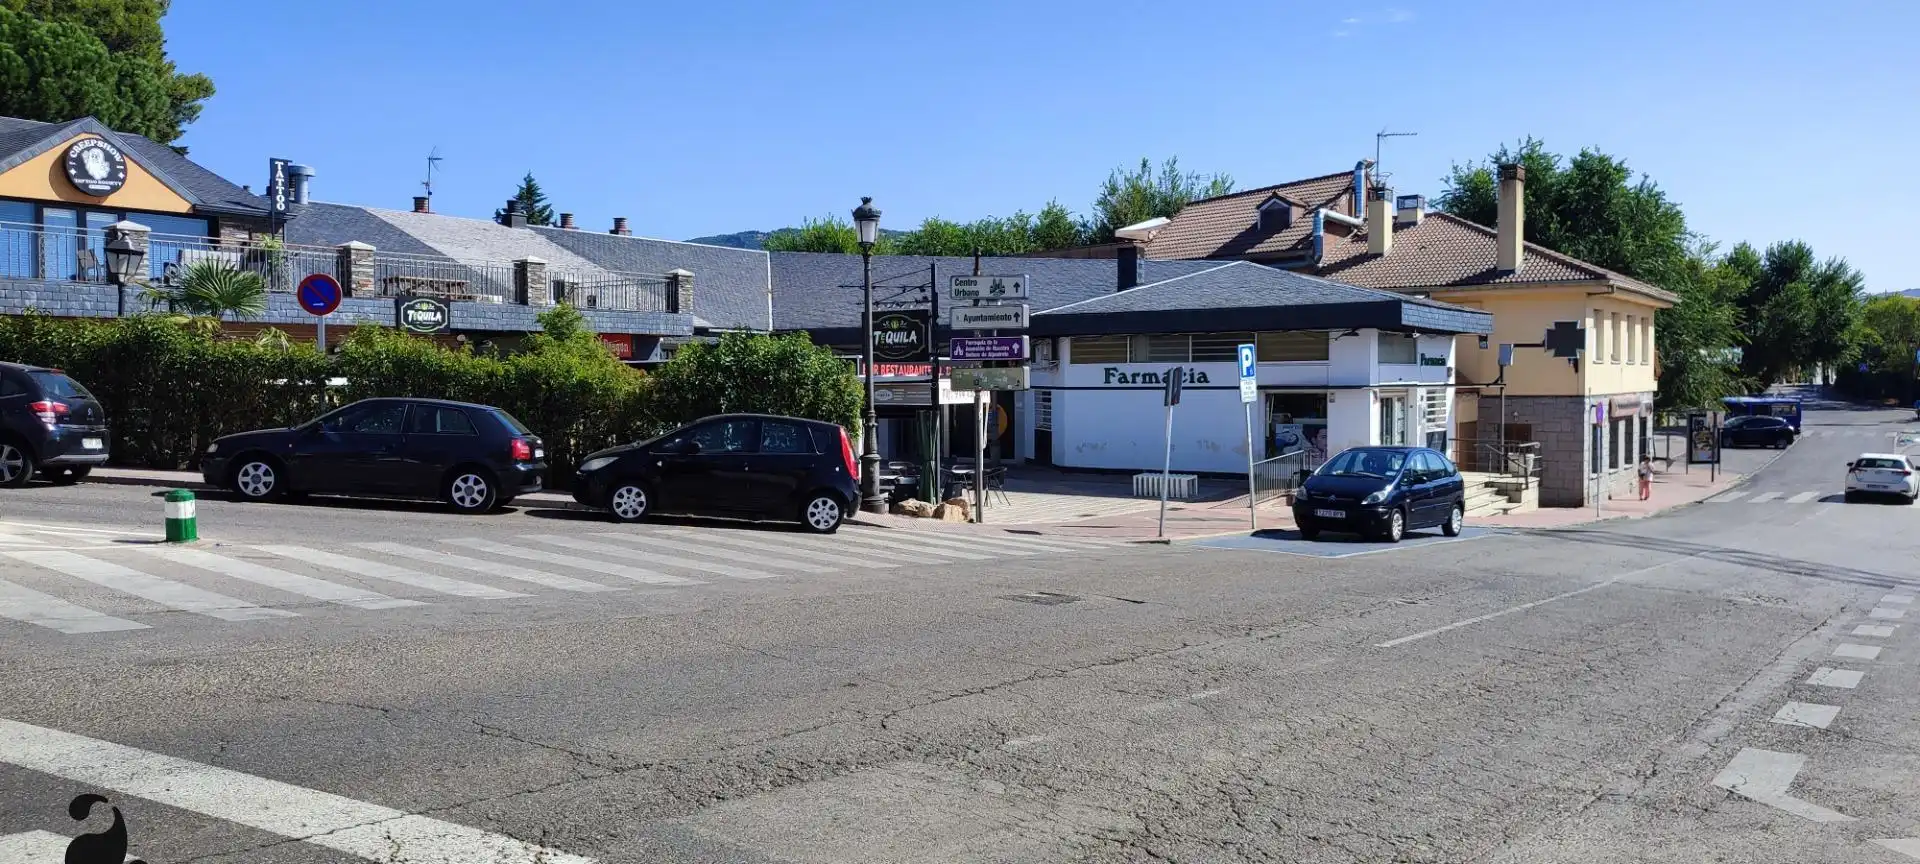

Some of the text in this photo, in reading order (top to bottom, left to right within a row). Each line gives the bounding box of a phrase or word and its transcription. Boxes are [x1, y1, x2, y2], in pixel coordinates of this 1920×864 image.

[70, 139, 123, 161] CREEPSHOW
[275, 161, 285, 210] TATTOO
[954, 278, 978, 287] Centro
[954, 288, 980, 297] Urbano
[963, 313, 1012, 324] Ayuntamiento
[1242, 348, 1253, 376] P
